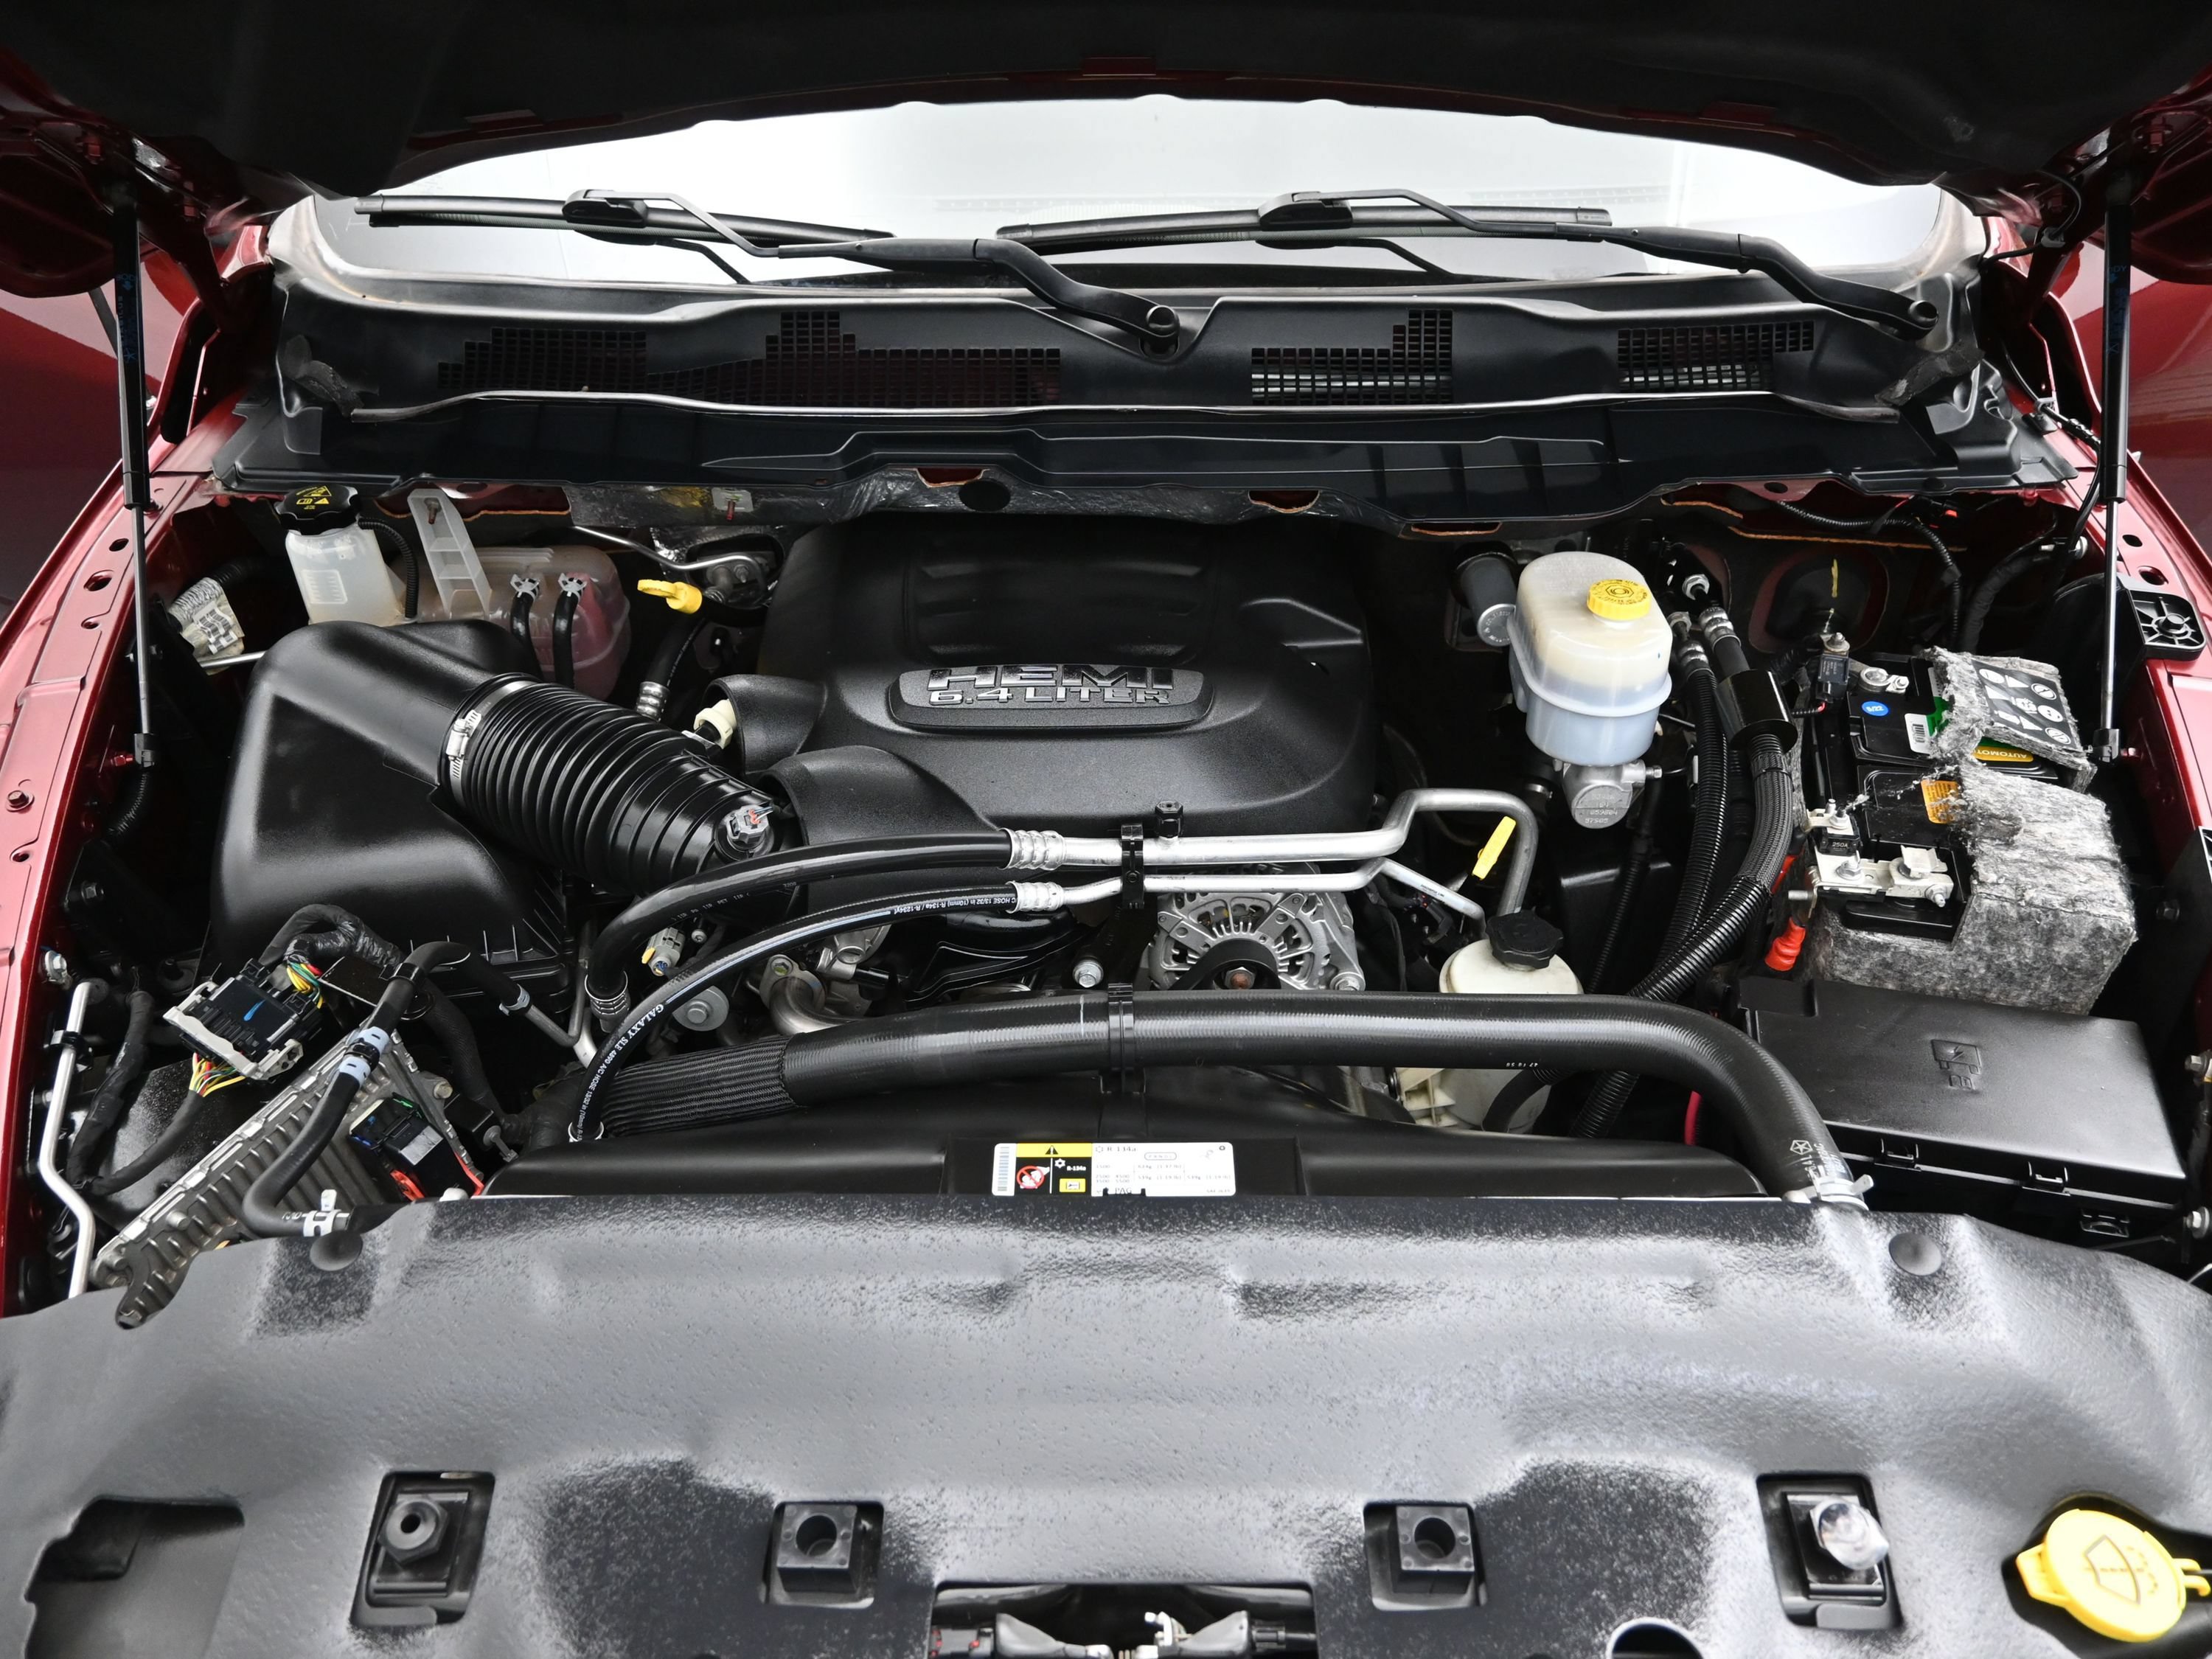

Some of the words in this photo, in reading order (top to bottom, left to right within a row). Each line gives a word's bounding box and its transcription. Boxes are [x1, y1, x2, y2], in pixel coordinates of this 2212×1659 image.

[928, 664, 1174, 691] HEMI
[929, 687, 1014, 706] 6.4
[1024, 686, 1170, 705] LITER
[947, 899, 969, 907] (10mm)
[627, 1004, 664, 1040] GALAXY
[614, 1036, 629, 1051] SLE
[597, 1063, 608, 1076] A/C
[590, 1074, 601, 1091] HOSE
